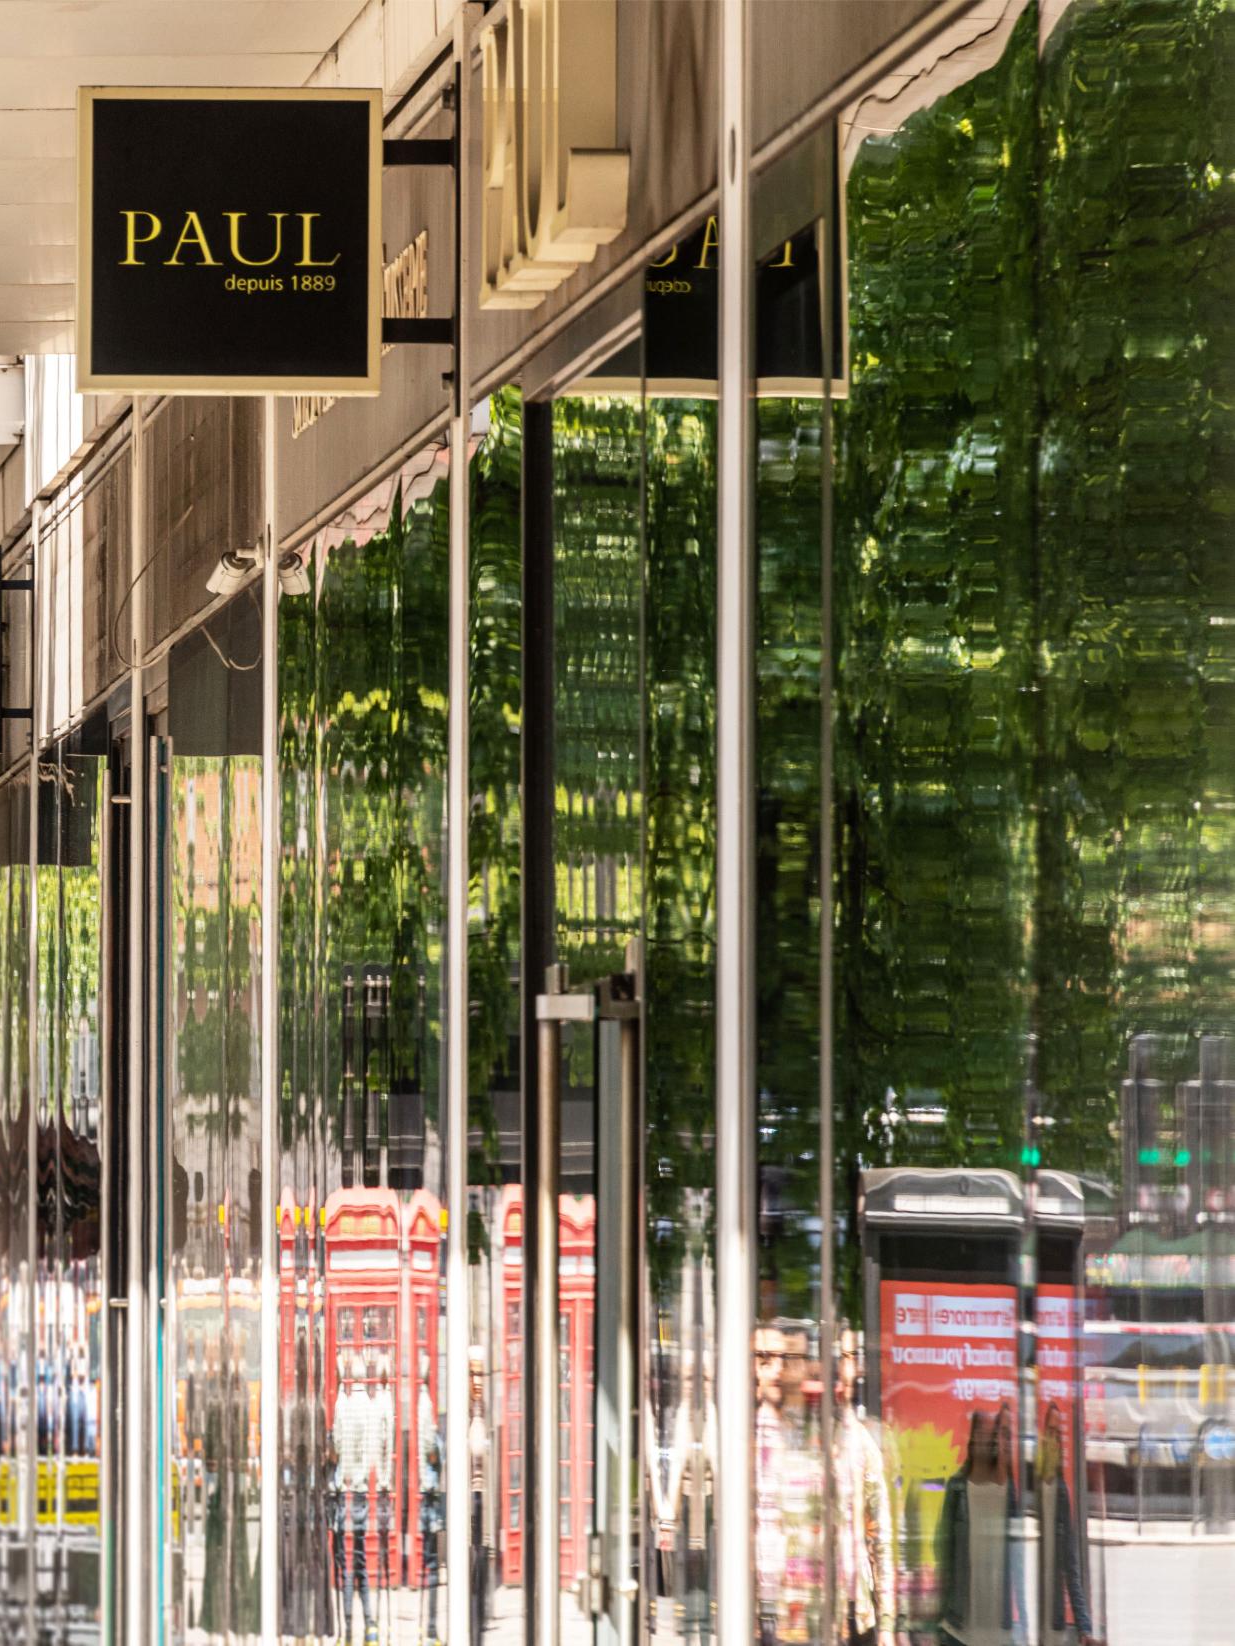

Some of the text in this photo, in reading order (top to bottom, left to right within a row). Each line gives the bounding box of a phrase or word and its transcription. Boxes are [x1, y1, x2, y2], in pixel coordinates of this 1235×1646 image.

[117, 210, 342, 267] PAUL
[224, 273, 336, 295] depuis 1889
